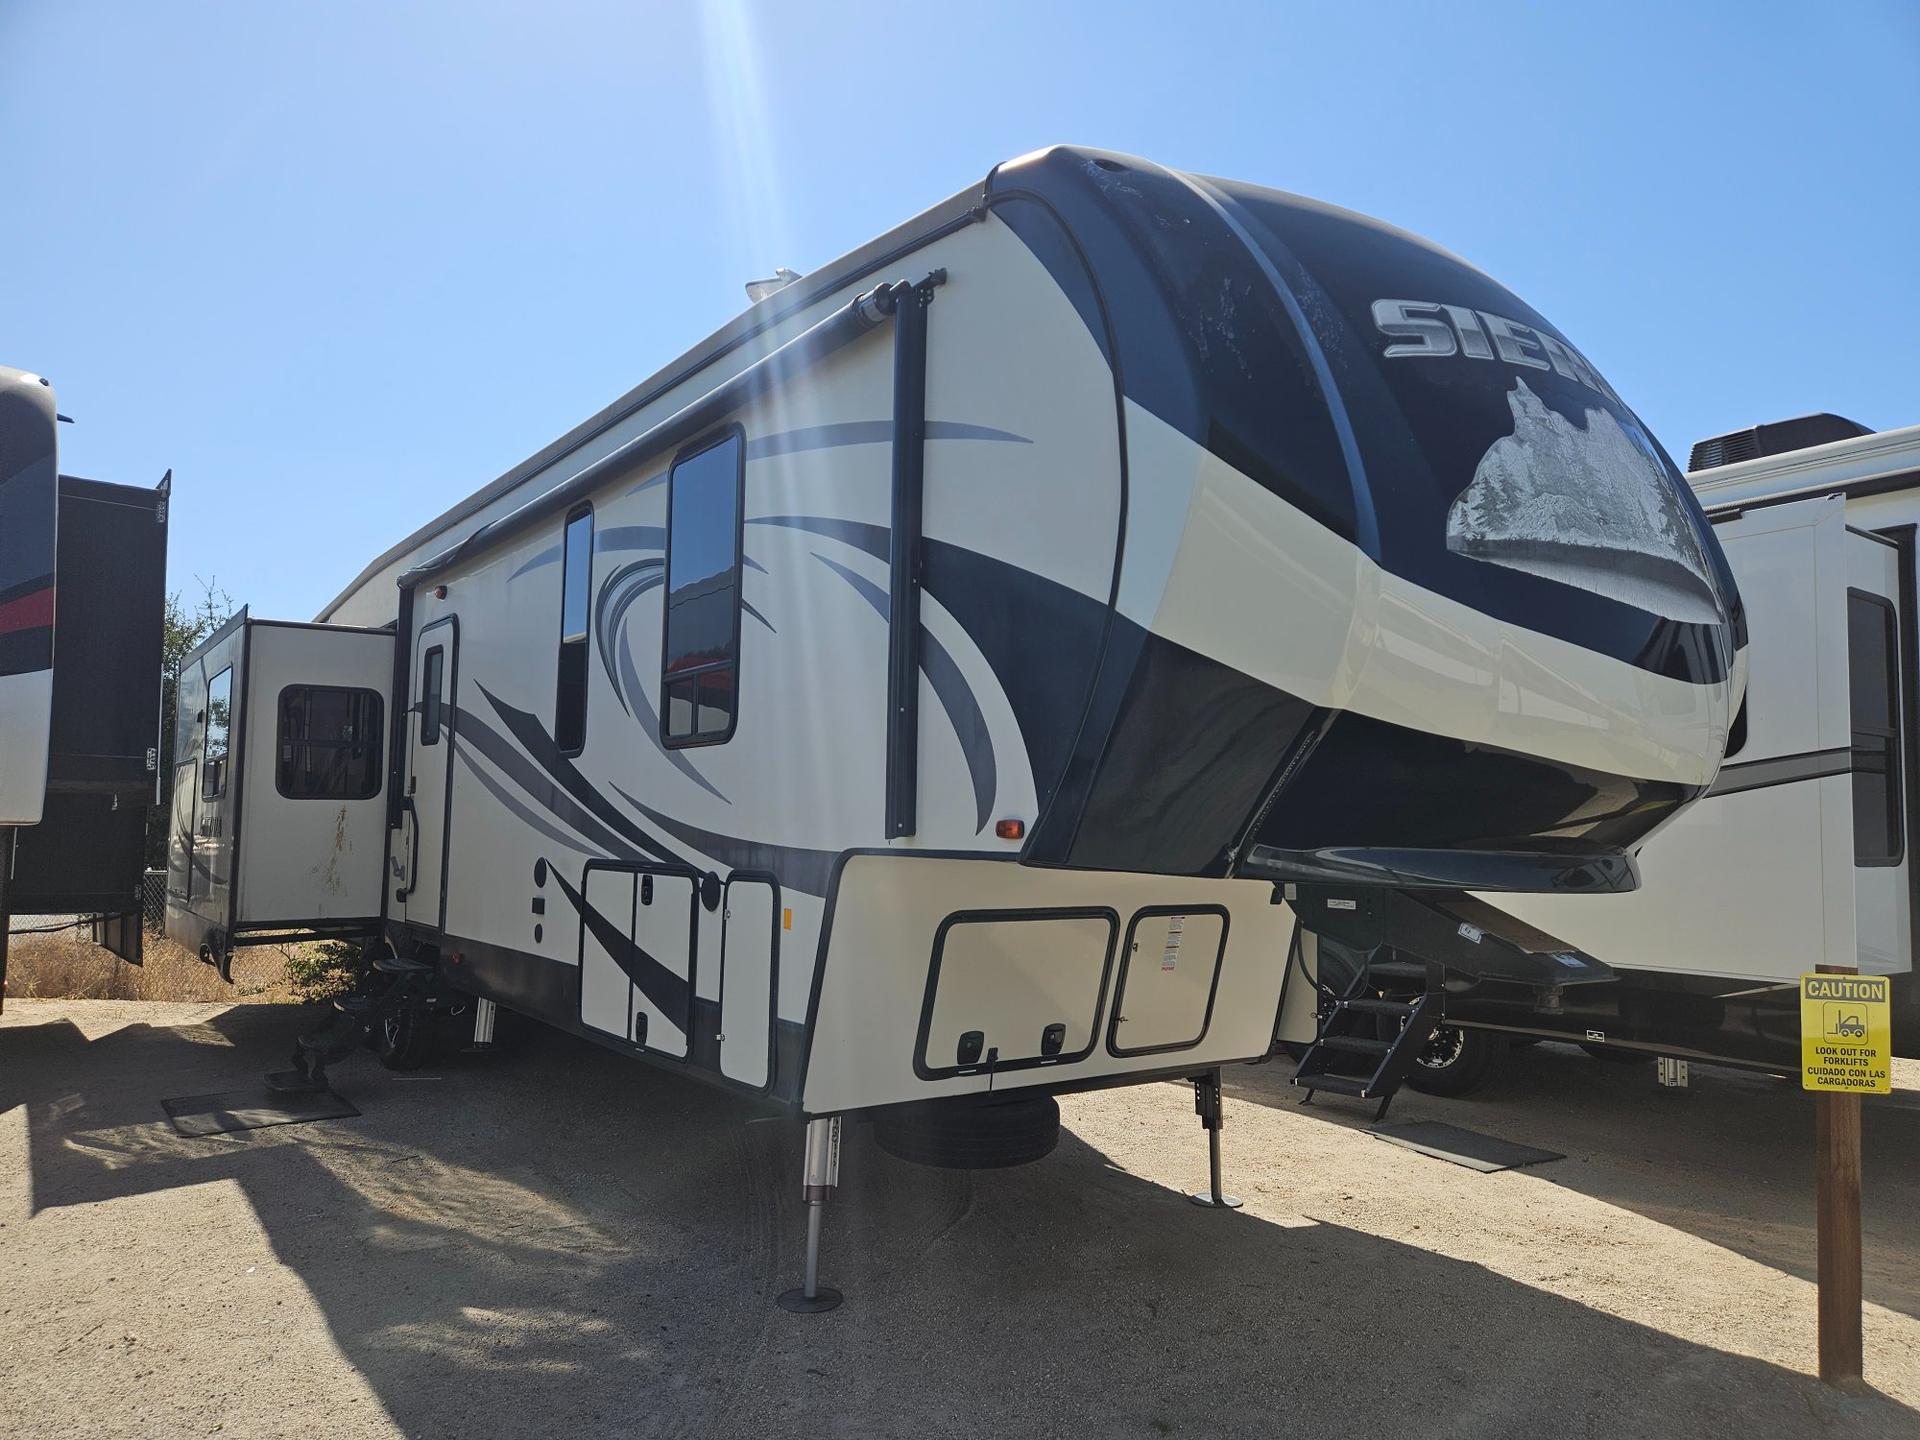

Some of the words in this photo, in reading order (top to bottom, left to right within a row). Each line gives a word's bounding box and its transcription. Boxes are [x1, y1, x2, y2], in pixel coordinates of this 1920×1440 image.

[1807, 981, 1883, 999] CAUTION
[1815, 1046, 1838, 1056] LOOK
[1840, 1047, 1857, 1057] OUT
[1860, 1048, 1877, 1058] FOR
[1823, 1056, 1869, 1067] FORKLIFTS
[1807, 1066, 1846, 1076] CUIDADO
[1848, 1068, 1867, 1078] CON
[1869, 1069, 1886, 1079] LAS
[1817, 1077, 1876, 1088] CARGADORAS
